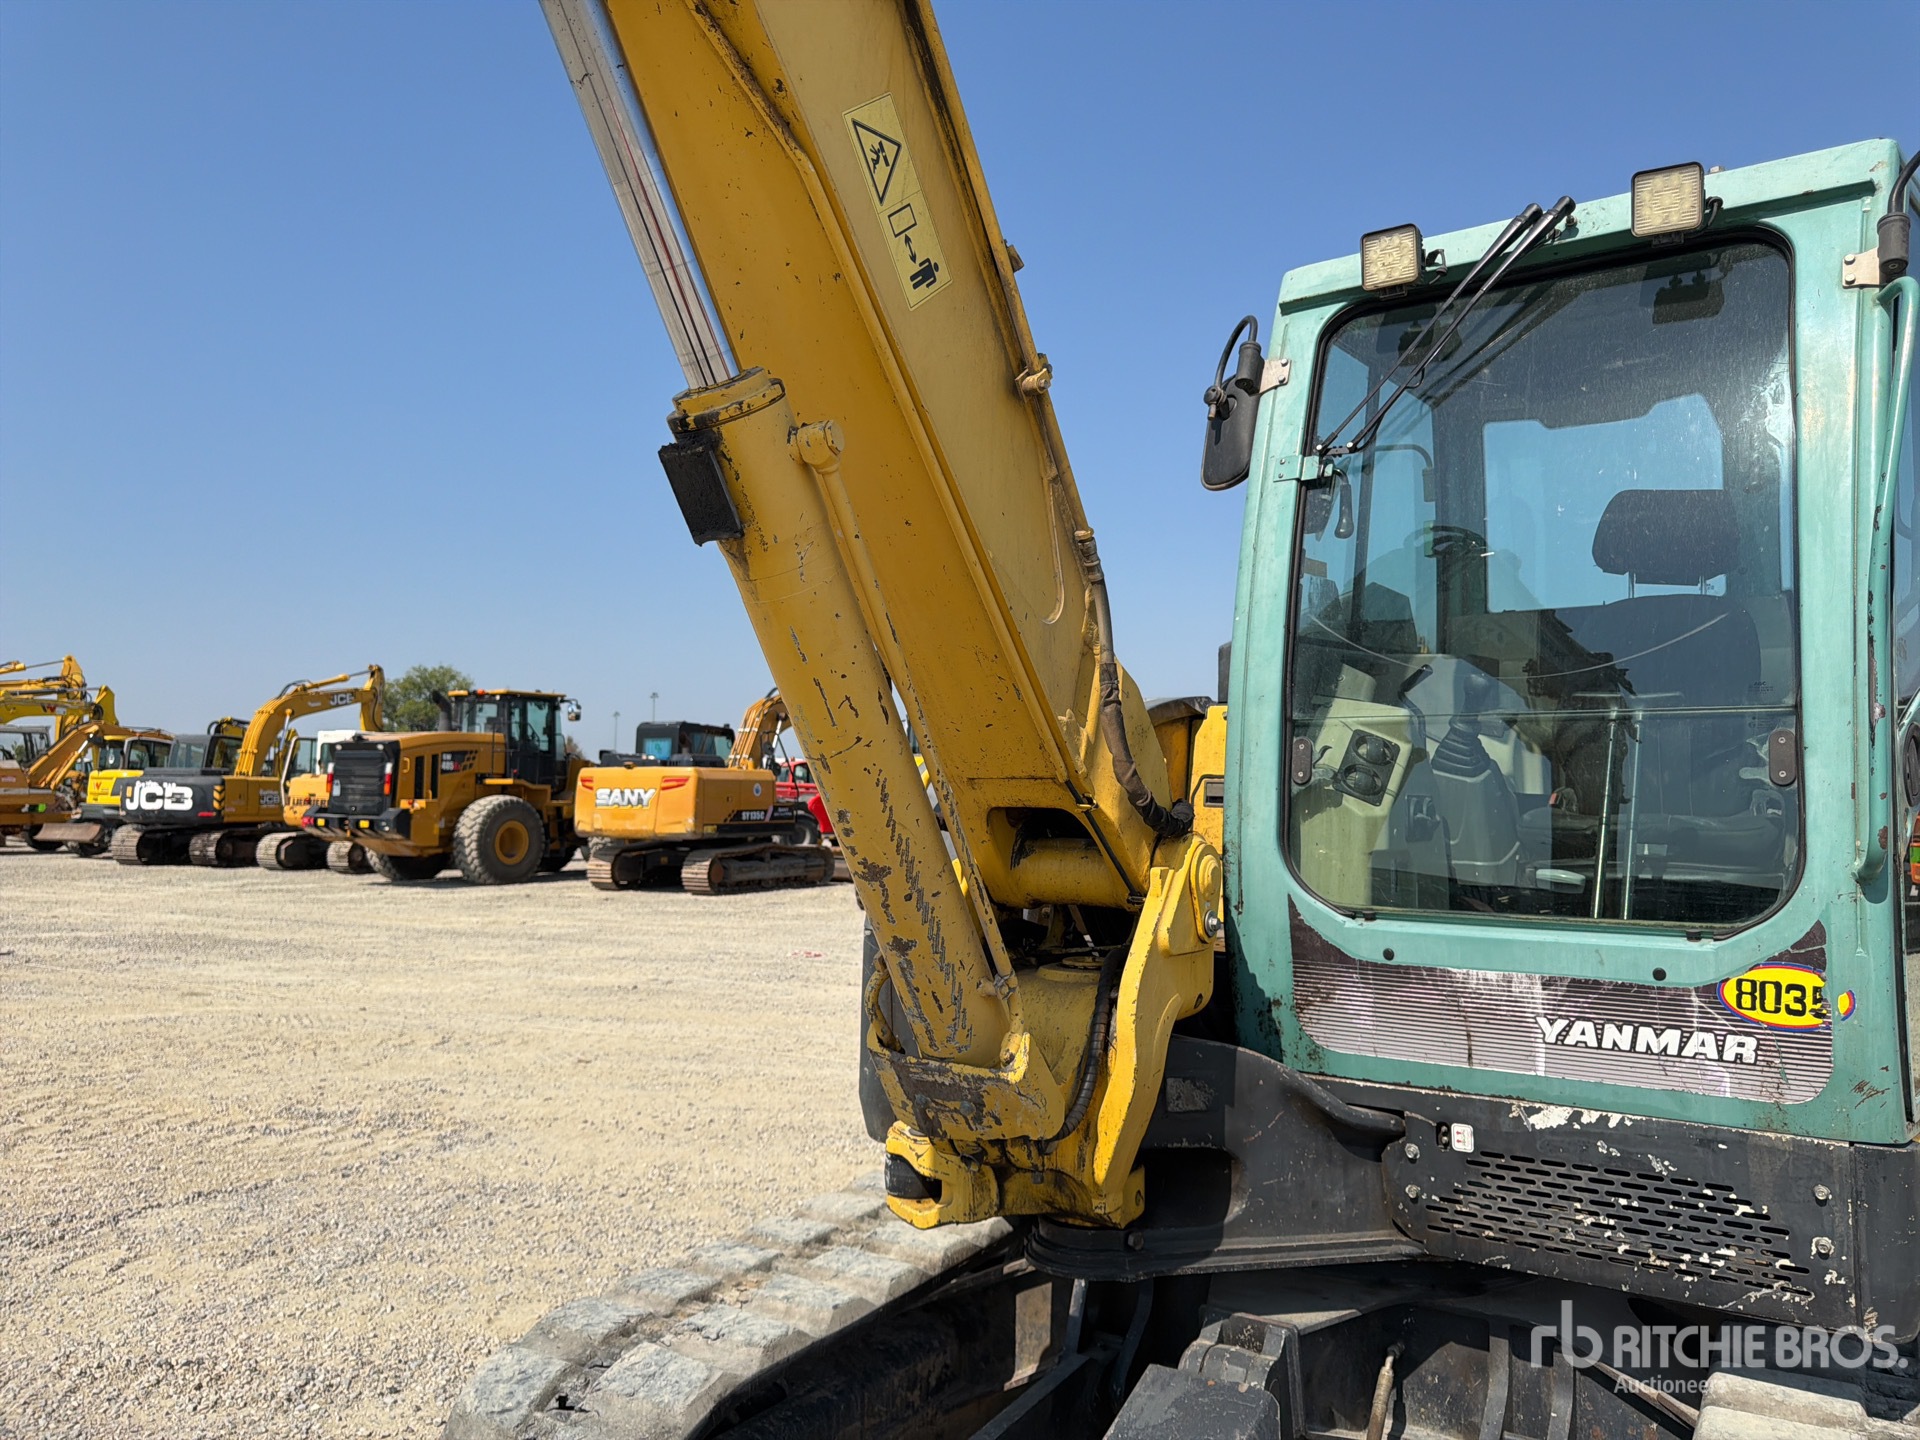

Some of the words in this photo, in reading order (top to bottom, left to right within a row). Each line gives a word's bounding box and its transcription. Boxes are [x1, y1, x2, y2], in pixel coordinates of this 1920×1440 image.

[125, 783, 193, 811] JCB
[259, 794, 280, 805] JCB
[595, 788, 656, 806] SANY
[741, 811, 765, 821] SY135C
[1534, 1015, 1760, 1065] YANMAR
